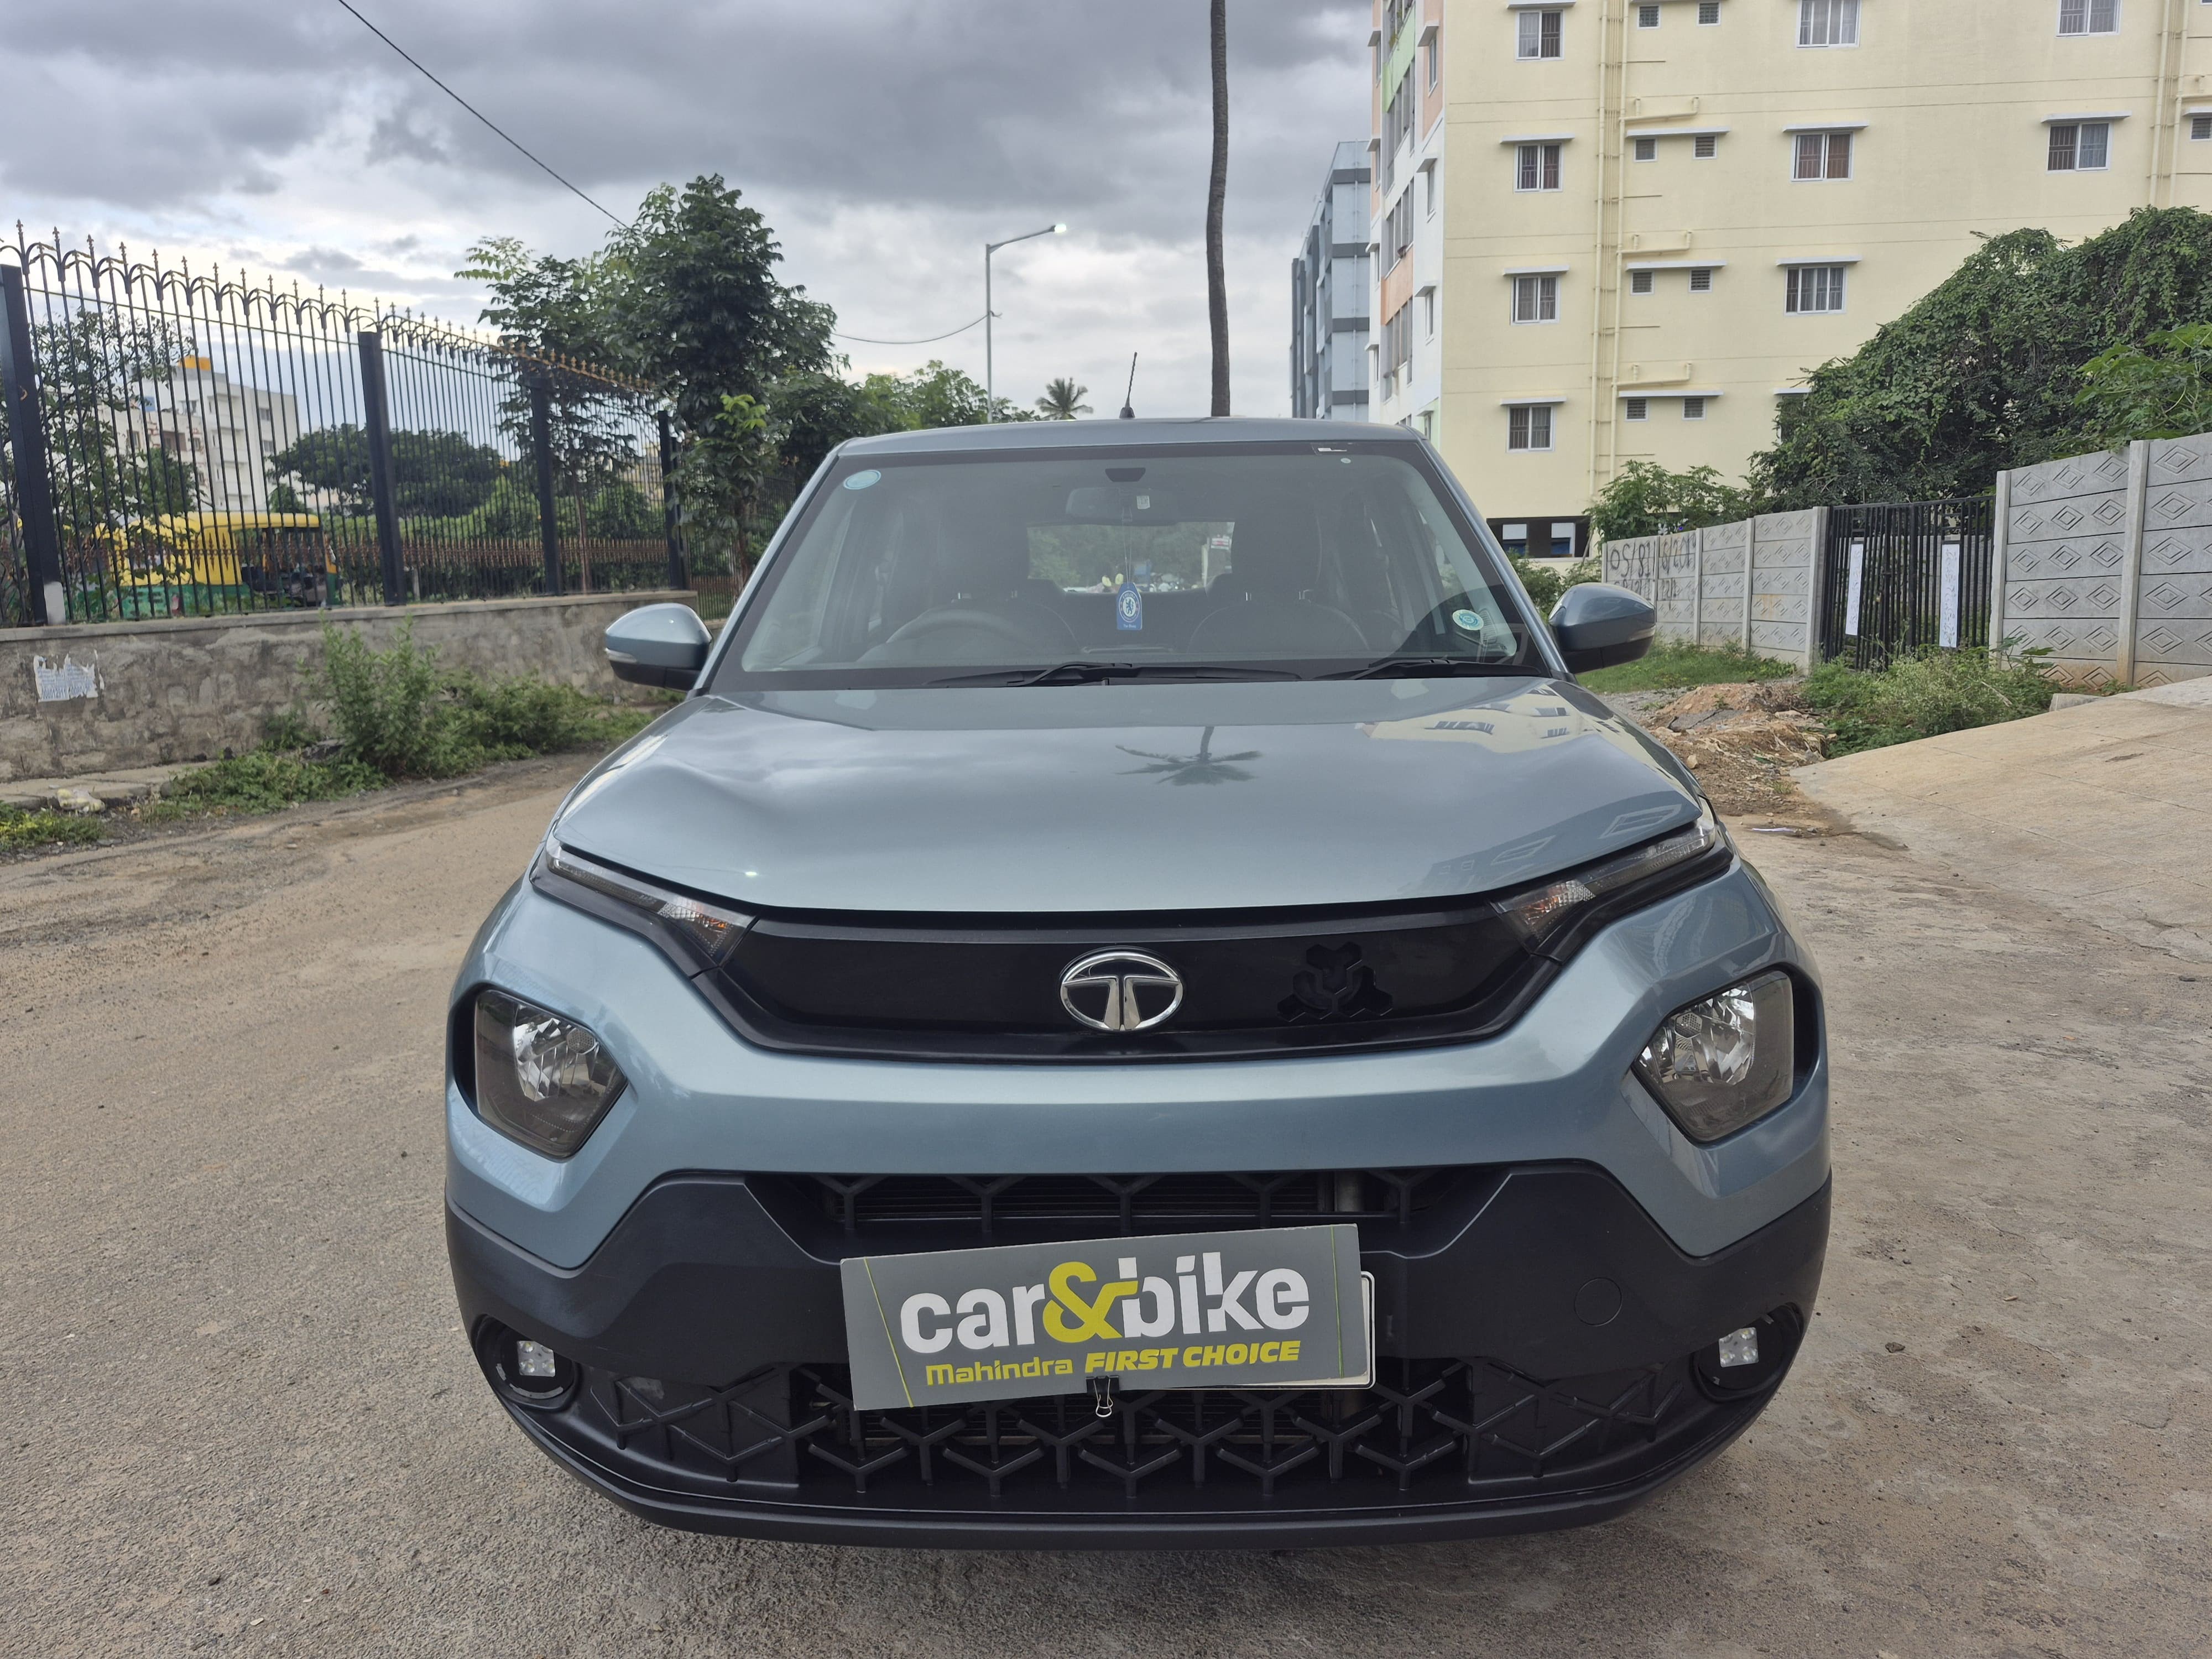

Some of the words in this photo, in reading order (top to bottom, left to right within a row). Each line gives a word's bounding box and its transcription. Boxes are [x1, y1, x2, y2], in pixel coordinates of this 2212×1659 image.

[900, 1251, 1310, 1353] car&bike
[926, 1356, 1073, 1386] Mahindra
[1084, 1347, 1180, 1374] FIRST
[1182, 1340, 1301, 1368] CHOICE
